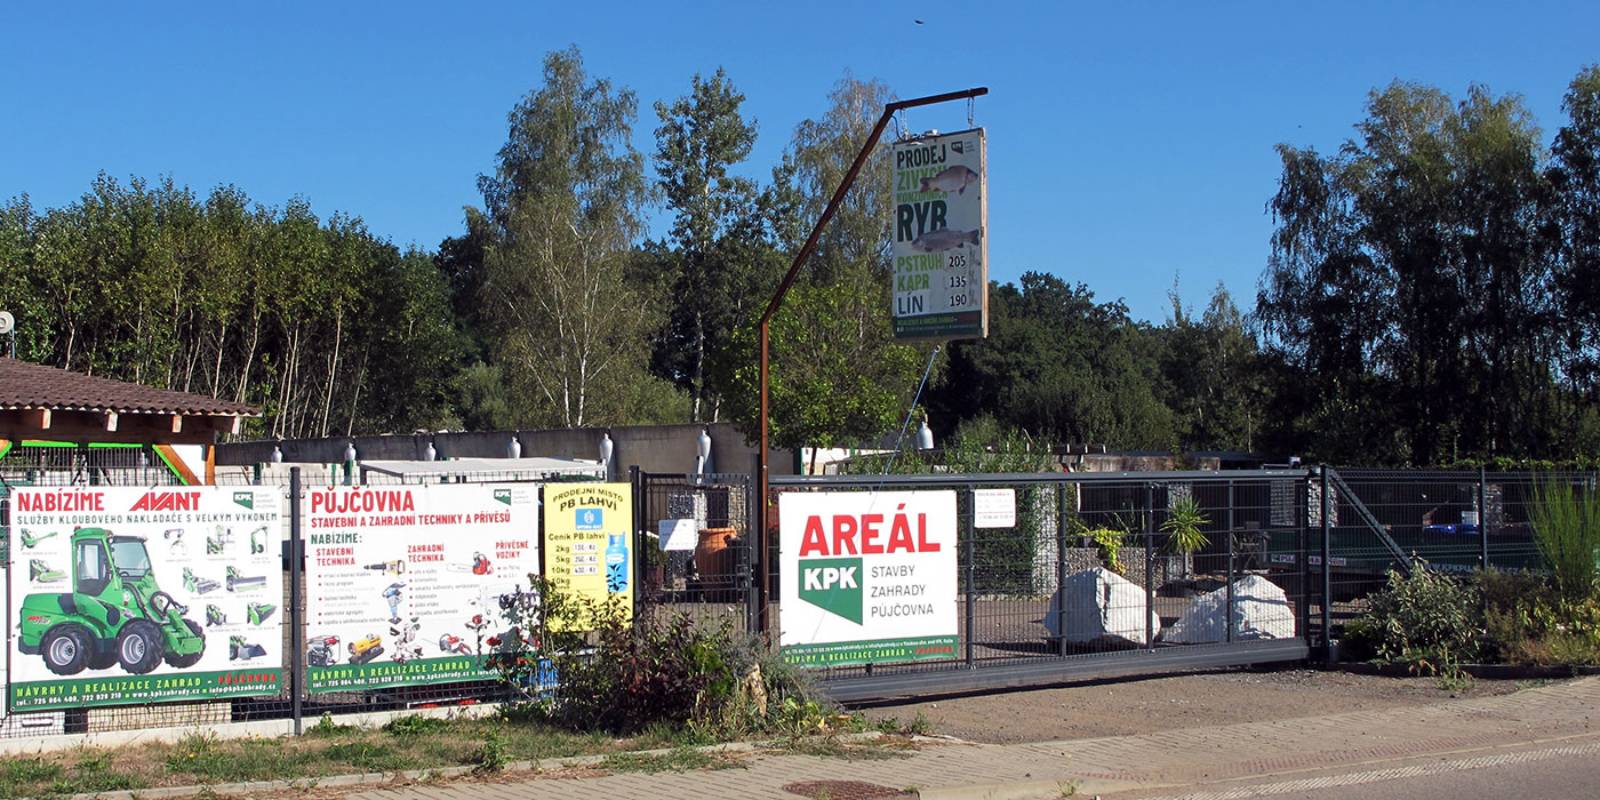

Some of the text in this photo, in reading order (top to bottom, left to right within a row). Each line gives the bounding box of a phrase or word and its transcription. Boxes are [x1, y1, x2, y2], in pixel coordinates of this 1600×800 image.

[896, 144, 946, 168] PRODEJ
[896, 200, 947, 241] RYB
[896, 252, 966, 272] PSTRUH 205
[896, 273, 967, 292] KAPR 135
[897, 291, 967, 314] LÍN 190
[17, 488, 201, 511] NABÍZÍME AVANT
[234, 493, 253, 501] KPK
[311, 485, 415, 513] PŮJČOVNA
[553, 488, 623, 502] PRODEJNÍ MÍSTO
[560, 496, 617, 512] PB LAHVÍ
[17, 511, 277, 525] SLUŽBY KLOUBOVÉHO NAKLADAČE S VELKÝM VÝKONEM
[311, 509, 511, 528] STAVEBNÍ A ZAHRADNÍ TECHNIKY A PŘÍVĚSŮ
[799, 503, 941, 557] AREÁL
[311, 531, 362, 544] NABÍZÍME:
[316, 547, 354, 556] STAVEBNÍ
[408, 543, 444, 553] ZAHRADNÍ
[556, 545, 570, 553] 2kg
[316, 558, 355, 566] TECHNIKA
[408, 554, 444, 563] TECHNIKA
[556, 556, 570, 564] 5kg
[552, 567, 570, 575] 10kg
[871, 565, 915, 578] STAVBY
[804, 566, 858, 591] KPK
[871, 585, 926, 598] ZAHRADY
[871, 603, 934, 617] PŮJČOVNA
[820, 654, 825, 662] A
[829, 651, 872, 661] REALIZACE
[876, 649, 905, 657] ZAHRAD
[312, 661, 471, 681] NÁVRHY A REALIZACE ZAHRAD
[16, 685, 64, 697] NÁVRHY
[71, 685, 78, 694] A
[85, 680, 150, 693] REALIZACE
[156, 678, 201, 689] ZAHRAD
